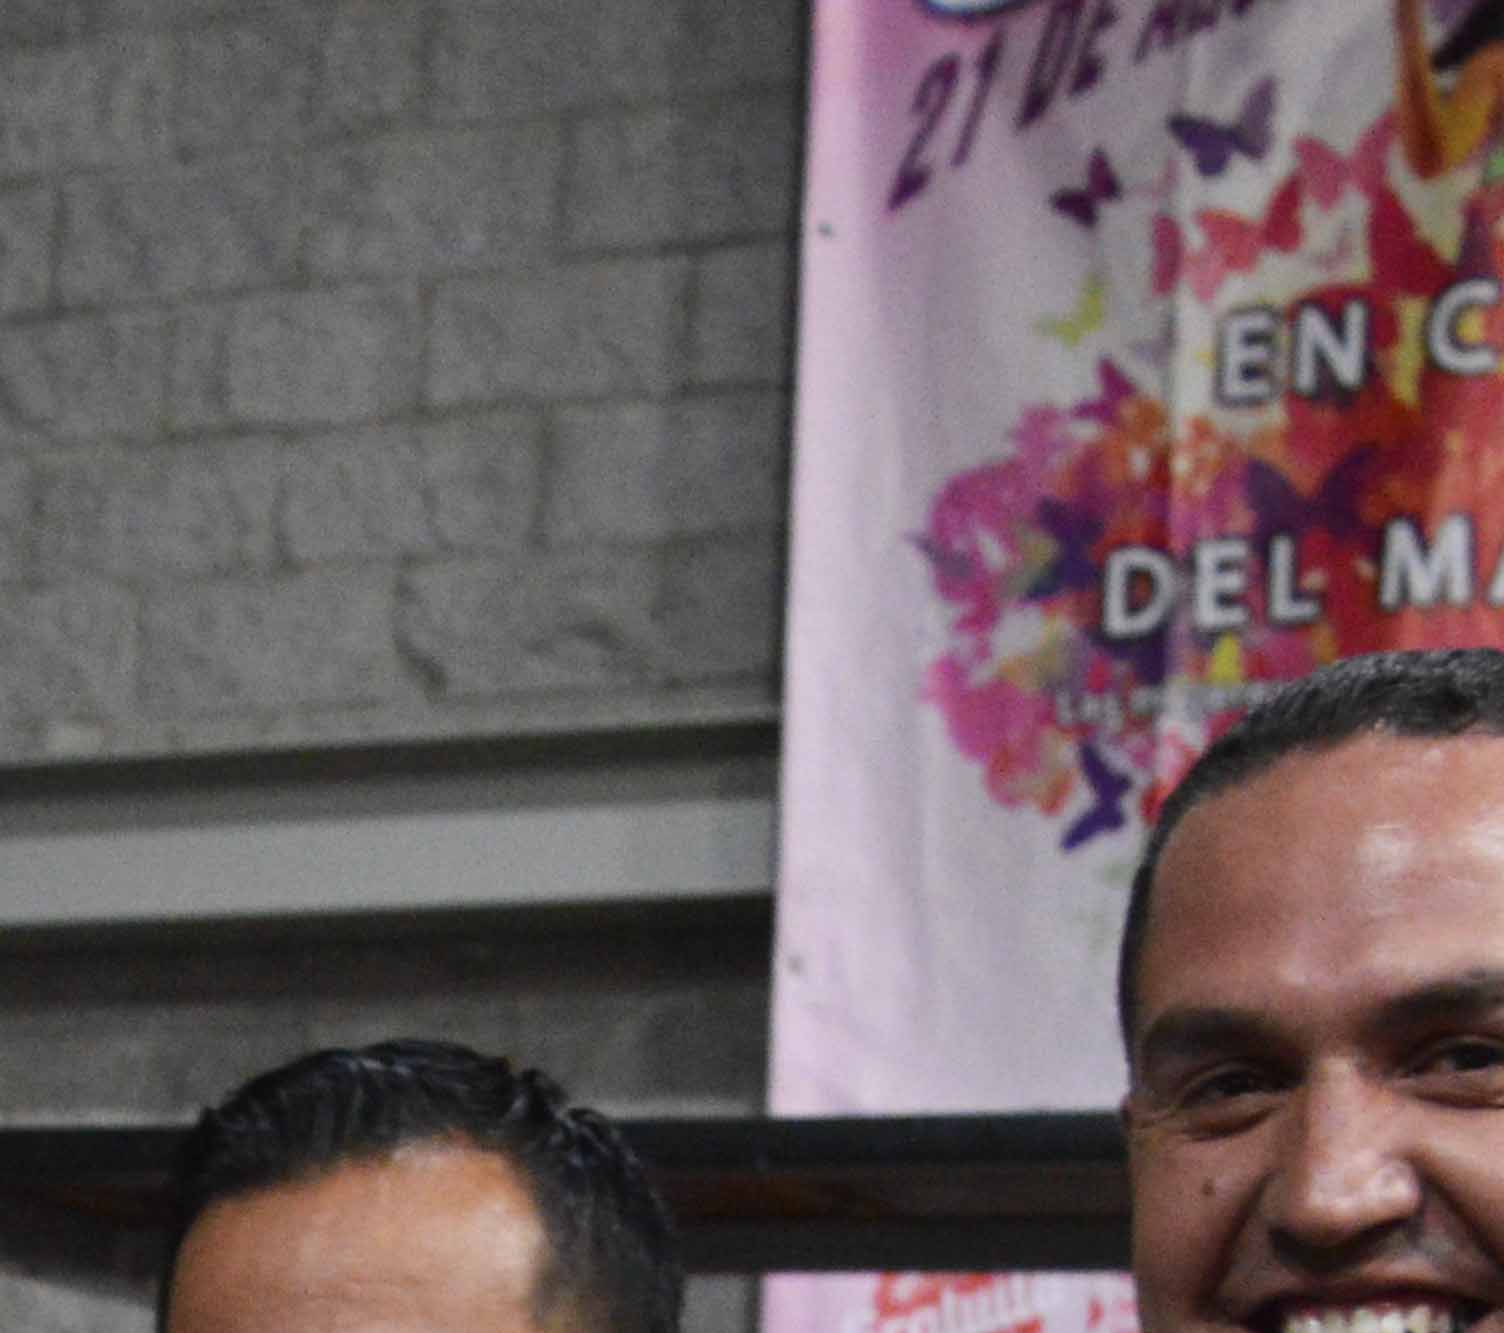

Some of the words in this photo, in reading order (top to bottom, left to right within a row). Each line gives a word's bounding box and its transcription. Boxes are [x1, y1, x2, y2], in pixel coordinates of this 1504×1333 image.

[888, 28, 1003, 211] 21
[1214, 298, 1372, 405] EN
[1100, 532, 1322, 642] DEL
